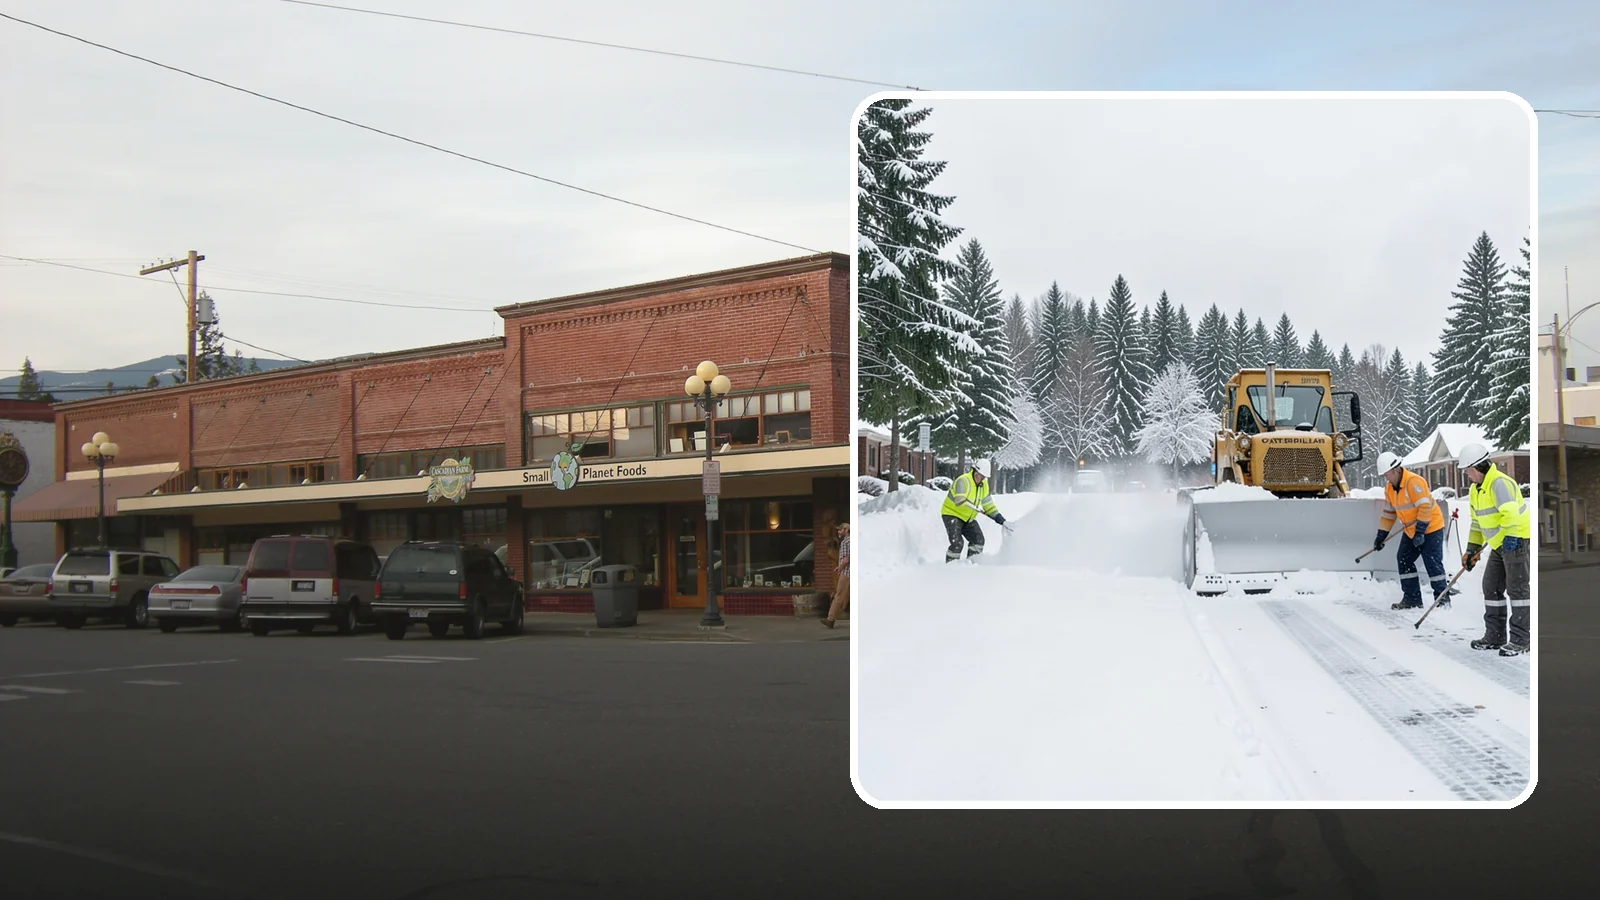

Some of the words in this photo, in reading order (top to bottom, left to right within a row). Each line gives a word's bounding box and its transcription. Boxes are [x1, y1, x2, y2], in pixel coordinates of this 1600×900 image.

[523, 471, 549, 483] Small
[583, 467, 613, 479] Planet
[617, 464, 647, 477] Foods
